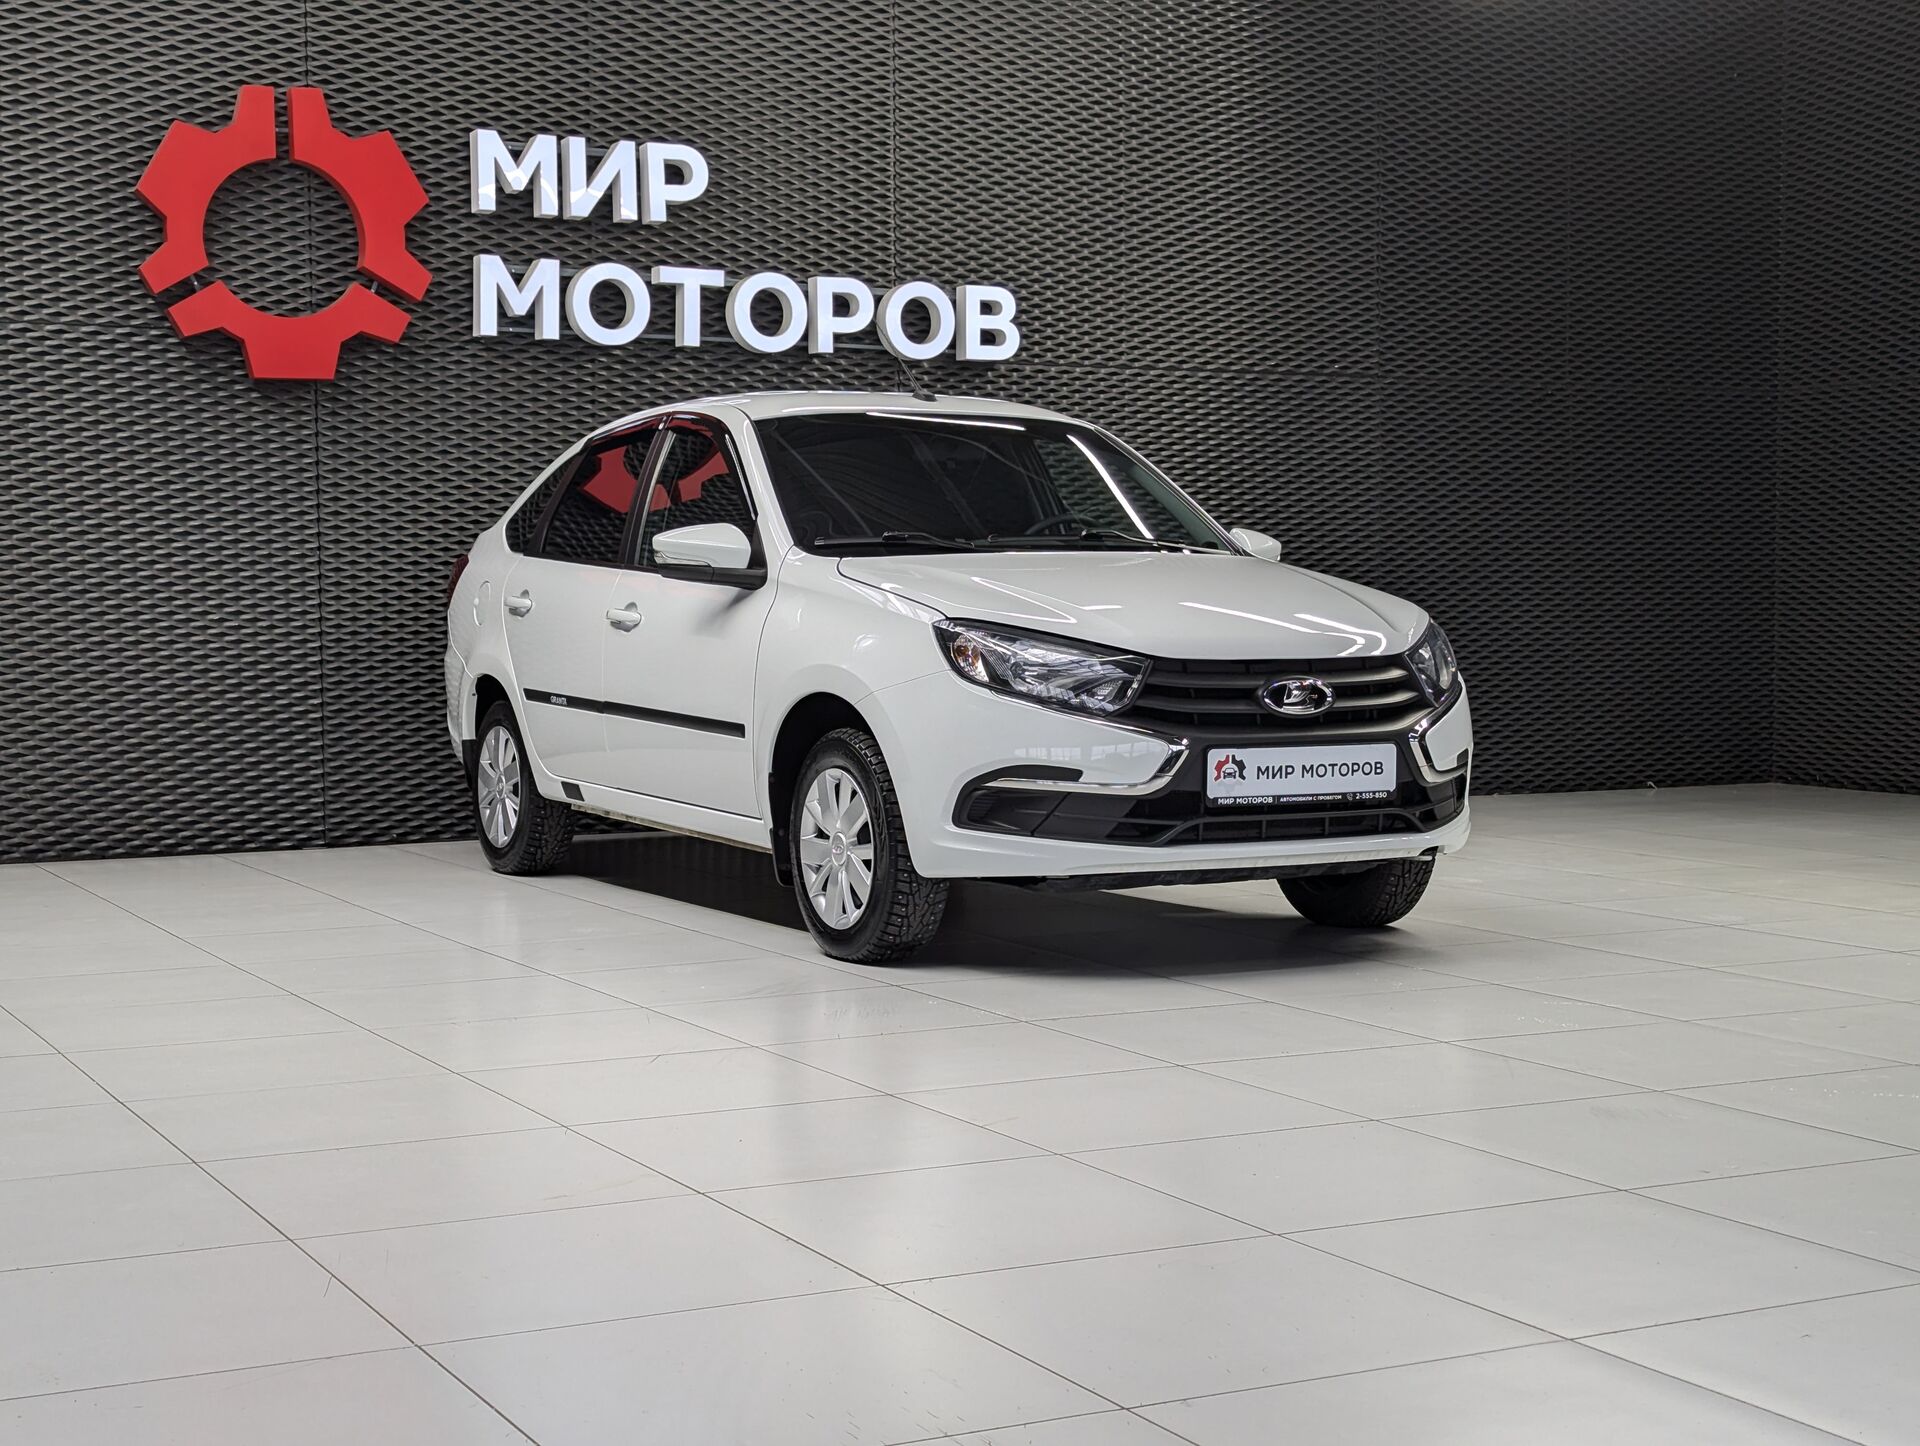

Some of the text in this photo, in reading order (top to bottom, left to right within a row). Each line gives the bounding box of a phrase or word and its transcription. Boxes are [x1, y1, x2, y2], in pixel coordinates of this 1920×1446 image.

[469, 128, 709, 225] МИР
[473, 254, 1021, 361] МОТОРОВ
[1217, 797, 1235, 805] МИР
[1236, 796, 1273, 804] МОТОРОВ
[1355, 791, 1388, 800] 2-555-850
[1256, 761, 1384, 780] МИР МОТОРОВ
